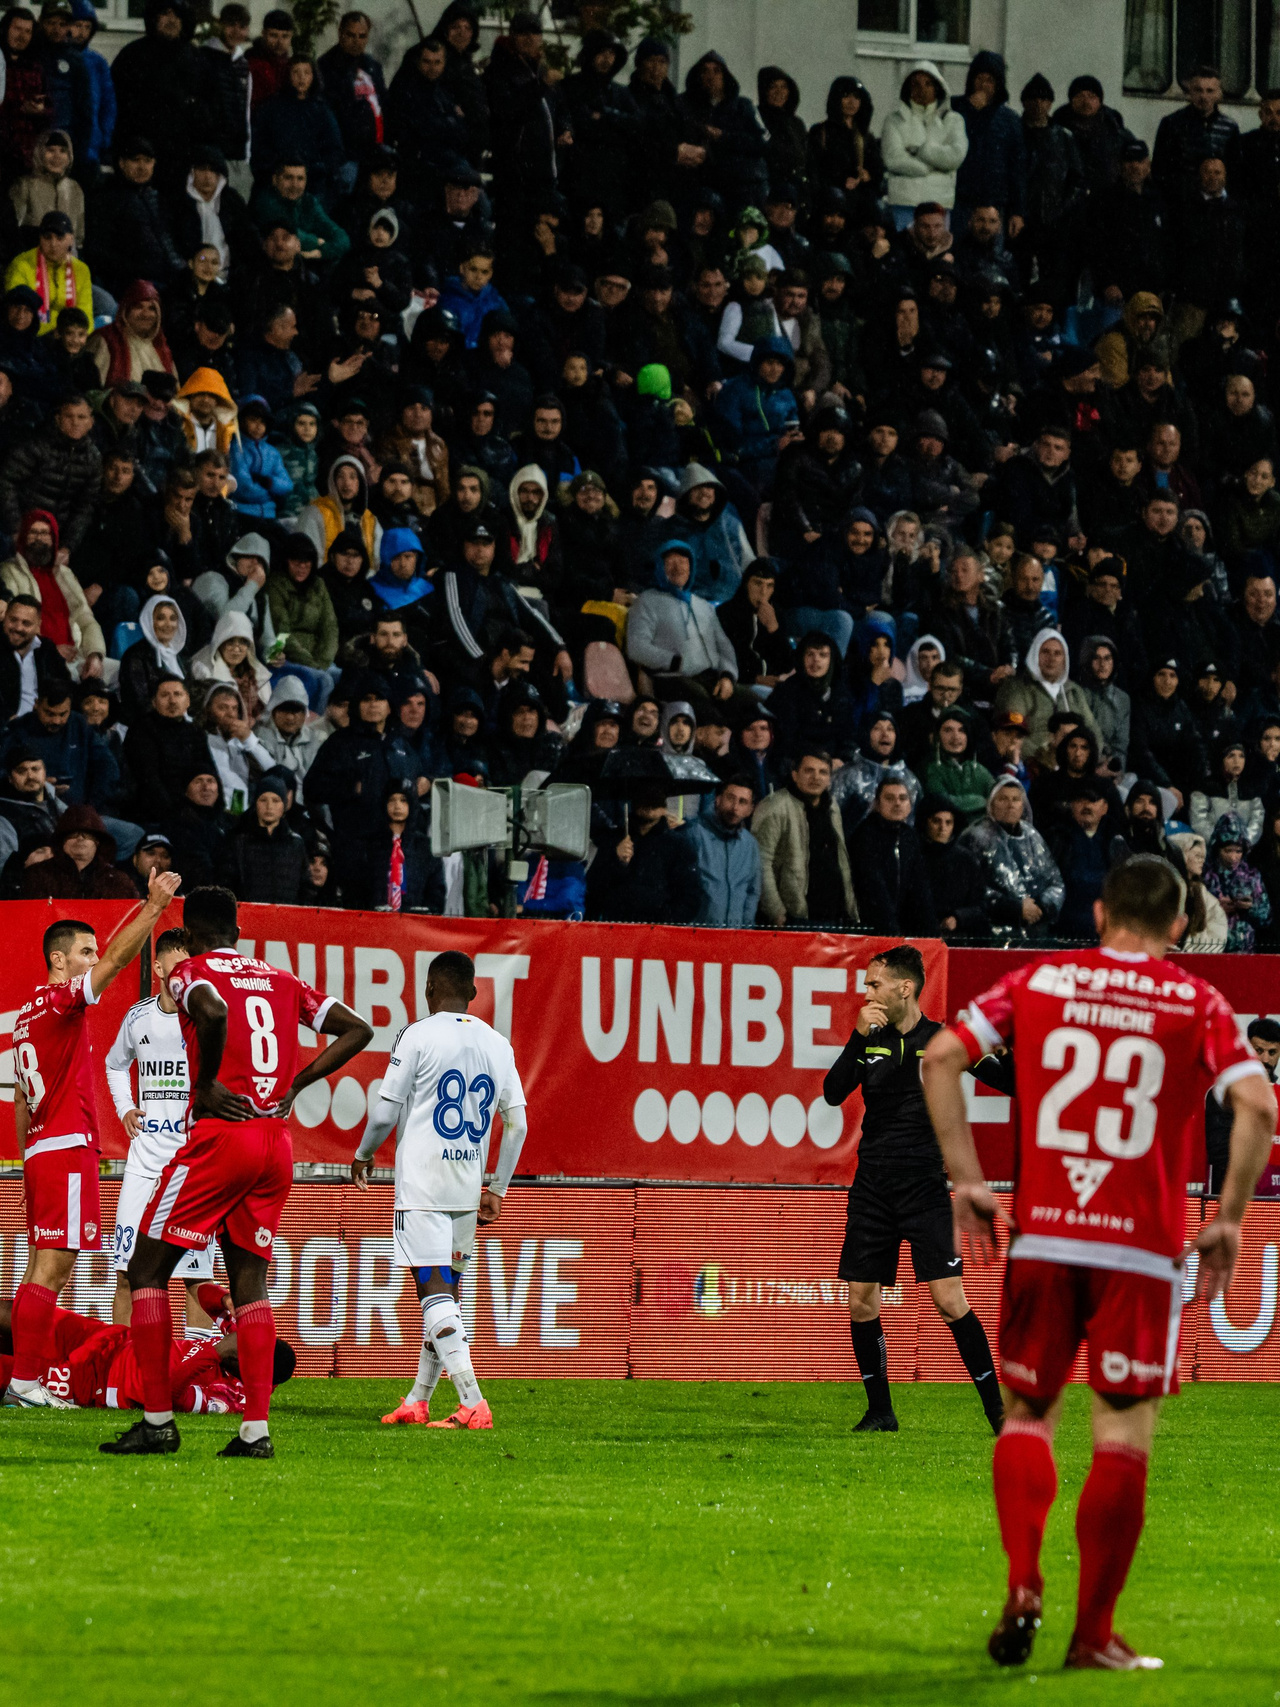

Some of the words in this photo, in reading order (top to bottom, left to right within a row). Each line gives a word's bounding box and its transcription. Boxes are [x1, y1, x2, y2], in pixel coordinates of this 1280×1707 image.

[229, 975, 275, 993] GNAHORÉ
[233, 938, 531, 1056] NIBT
[581, 955, 867, 1070] UNIBE
[1062, 1000, 1156, 1035] PATRICHE
[245, 995, 280, 1074] 8
[139, 1060, 187, 1077] UNIBE
[164, 1091, 180, 1100] SPRE
[432, 1068, 496, 1143] 83
[1036, 1026, 1166, 1160] 23
[140, 1115, 186, 1134] LSAC
[1064, 1208, 1136, 1234] GAMING
[115, 1224, 135, 1253] 93
[46, 1366, 71, 1397] 28
